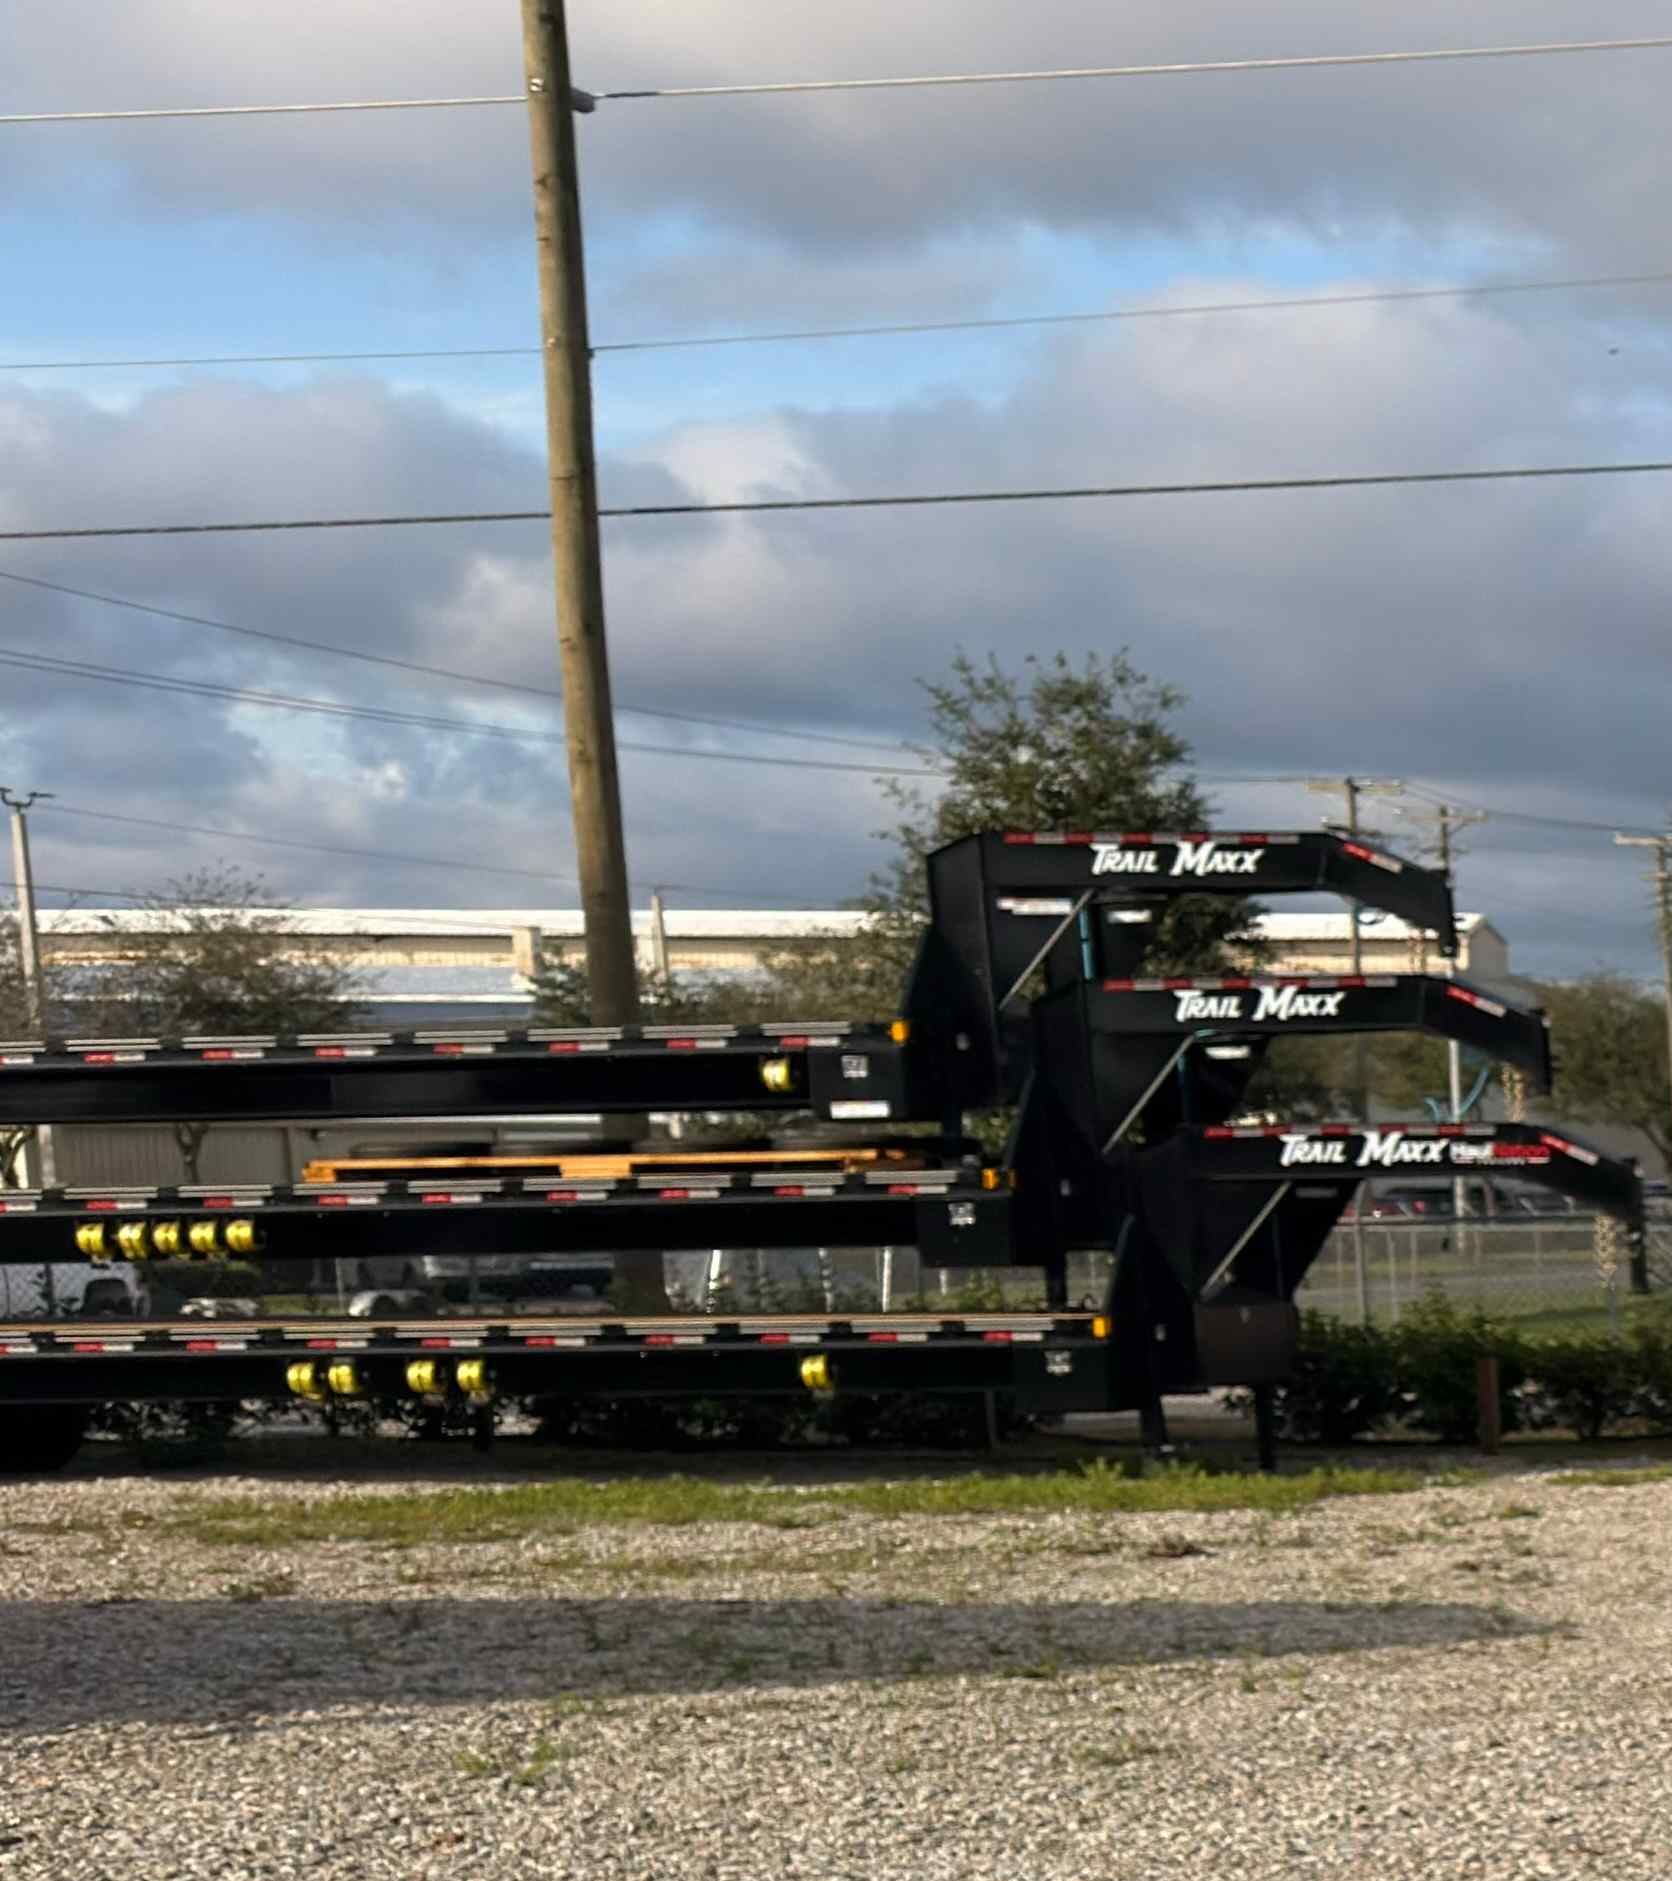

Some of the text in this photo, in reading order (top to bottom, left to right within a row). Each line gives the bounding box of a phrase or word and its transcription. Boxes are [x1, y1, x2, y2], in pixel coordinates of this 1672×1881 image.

[1089, 839, 1266, 877] TRAIL MAXX
[1172, 984, 1347, 1023] TRAIL MAXX
[1279, 1132, 1347, 1167] TRAIL
[1354, 1130, 1450, 1167] MAXX
